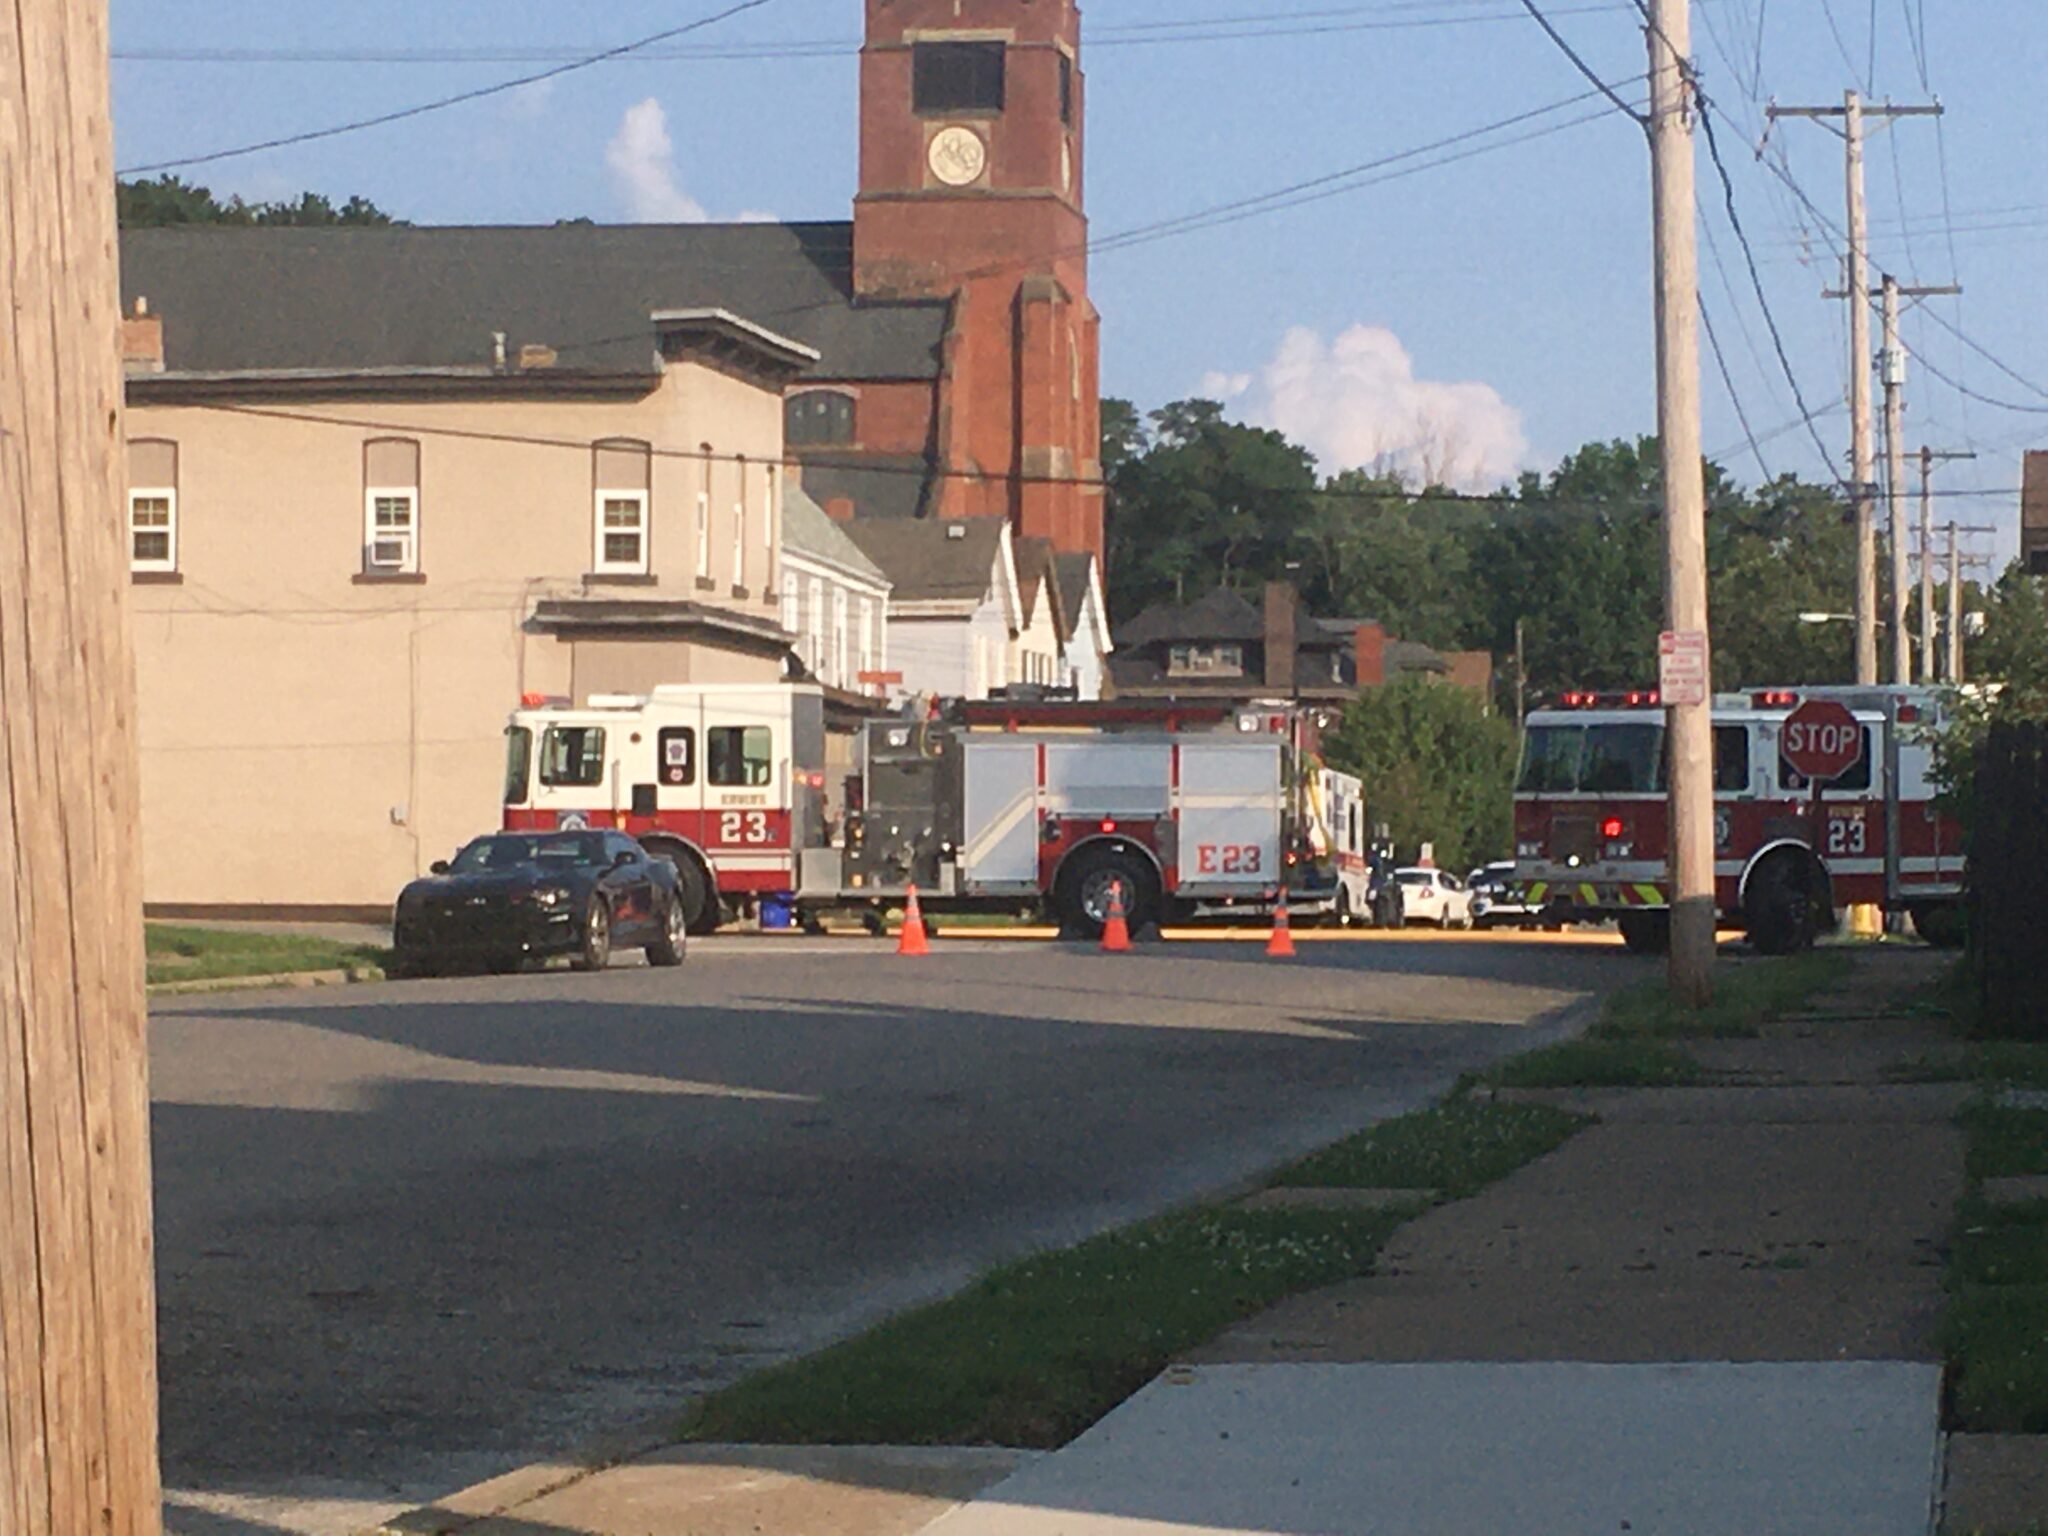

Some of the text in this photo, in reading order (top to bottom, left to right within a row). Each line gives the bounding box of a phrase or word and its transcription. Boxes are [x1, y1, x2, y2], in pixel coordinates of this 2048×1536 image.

[1787, 722, 1857, 755] STOP
[720, 811, 767, 843] 23
[1828, 820, 1865, 853] 23
